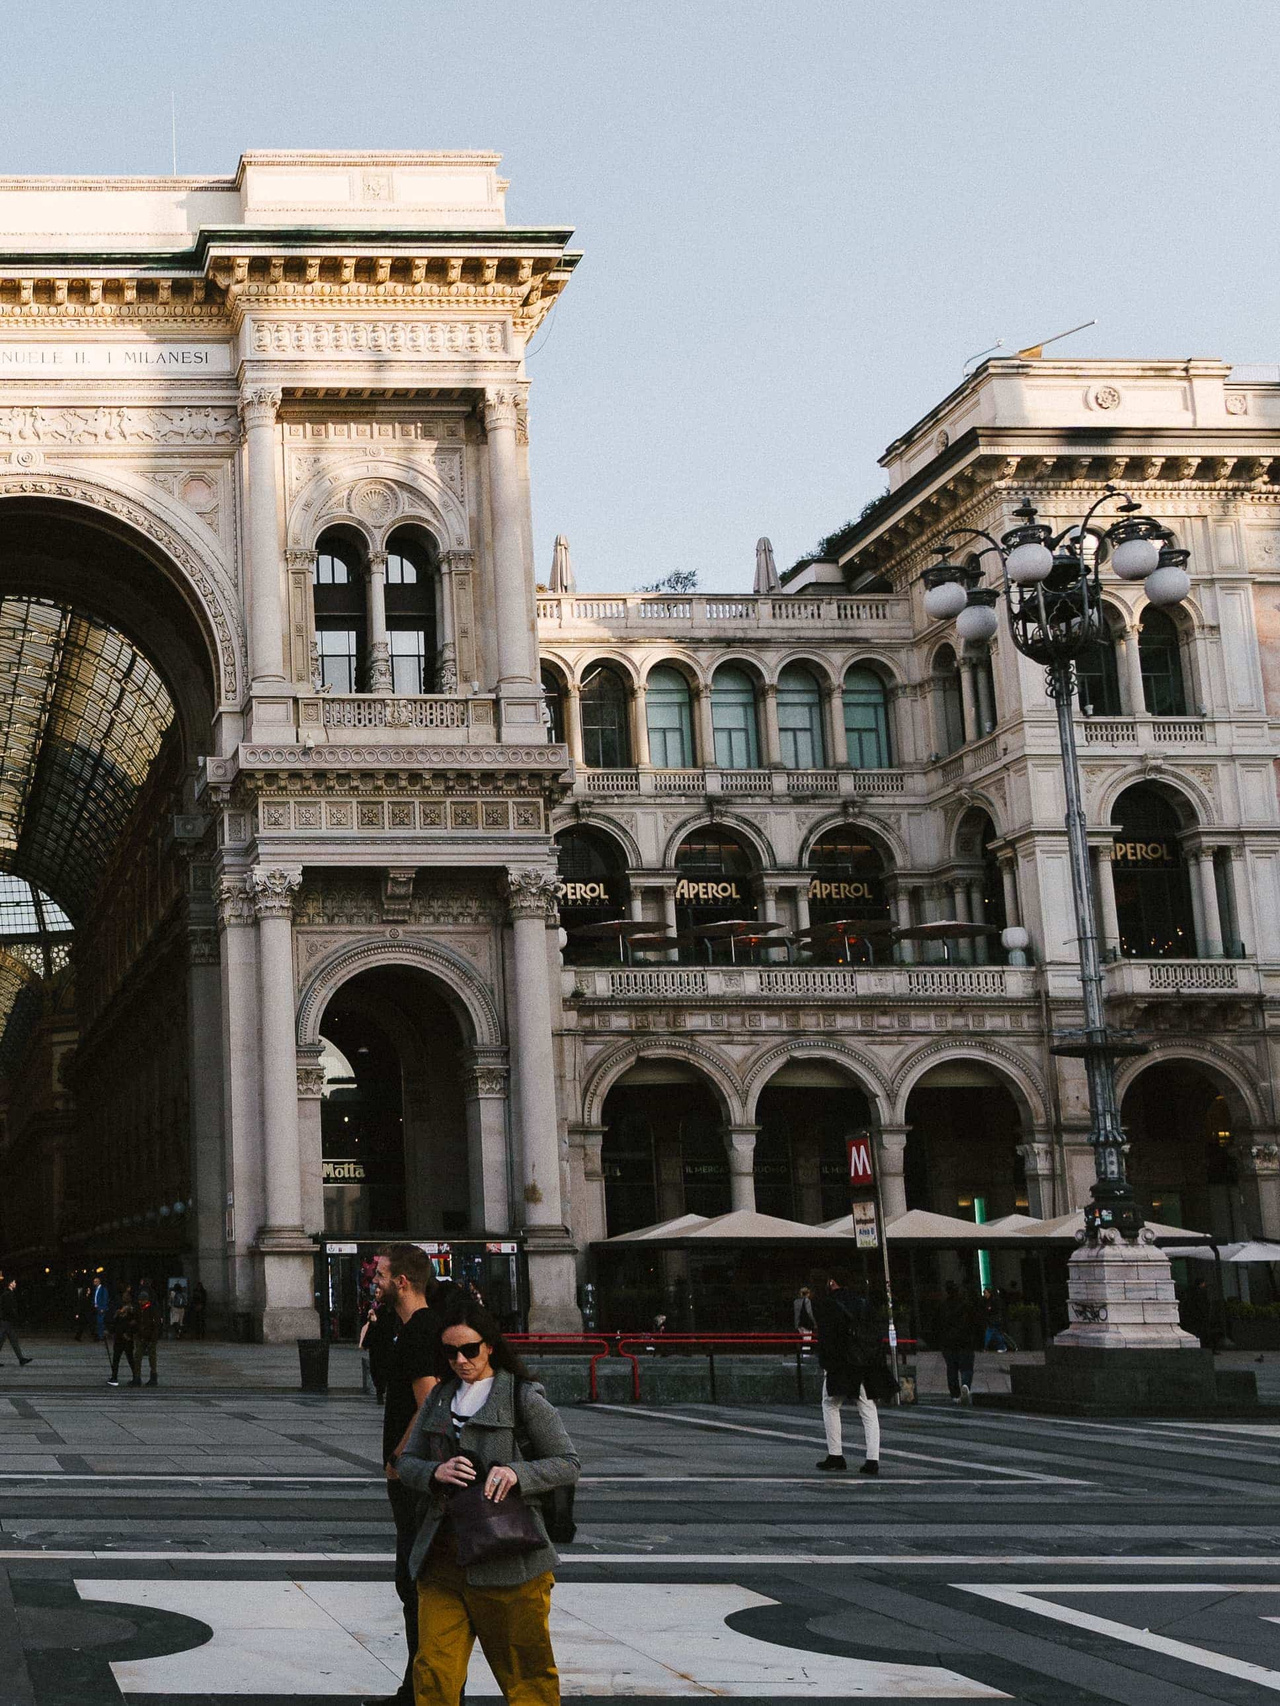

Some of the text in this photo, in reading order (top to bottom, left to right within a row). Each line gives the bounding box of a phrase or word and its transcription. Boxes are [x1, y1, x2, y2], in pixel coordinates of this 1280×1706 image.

[124, 352, 208, 364] MILANESI
[676, 879, 741, 899] APEROL
[808, 879, 873, 899] APEROL
[322, 1163, 365, 1178] Motta
[851, 1145, 871, 1177] M
